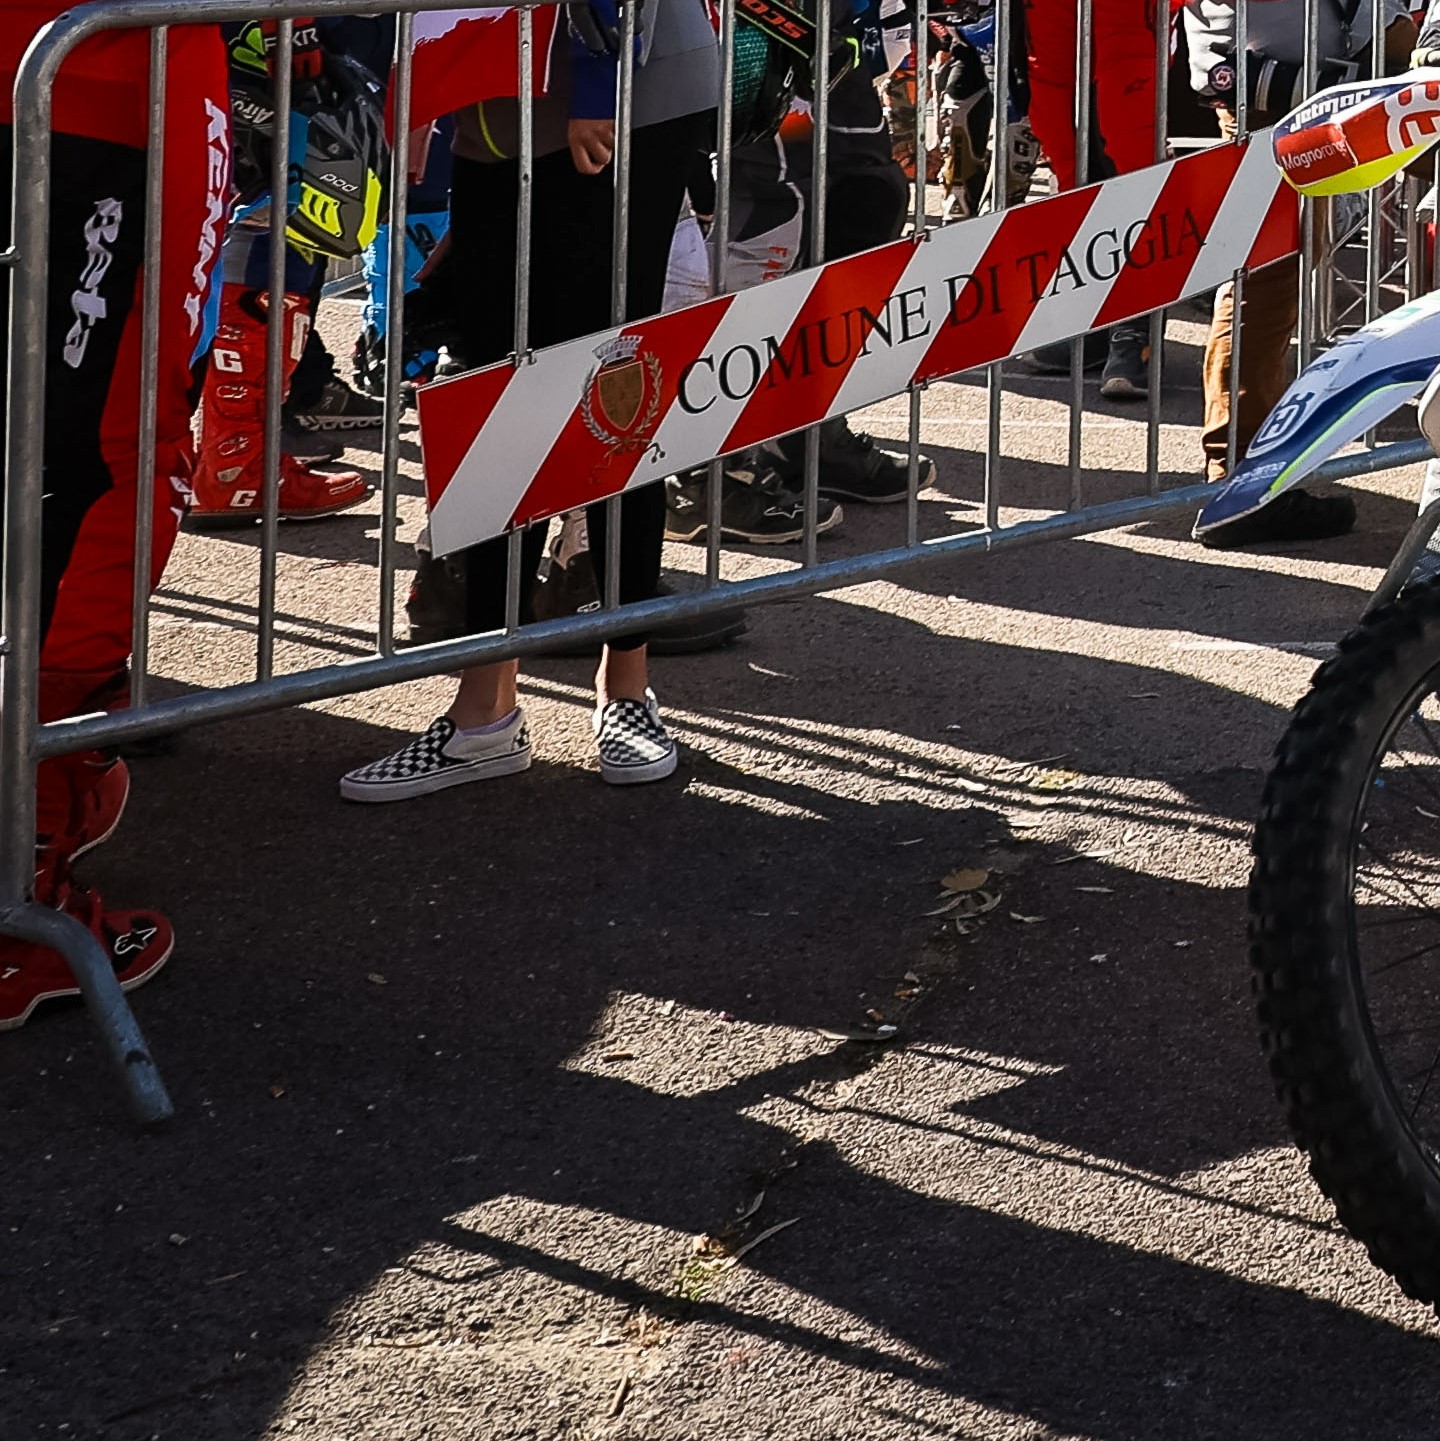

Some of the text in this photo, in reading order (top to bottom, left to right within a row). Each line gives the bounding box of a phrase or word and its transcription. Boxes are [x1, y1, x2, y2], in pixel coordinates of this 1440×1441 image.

[63, 197, 123, 368] Beta
[677, 206, 1206, 416] COMUNE DI TAGGIA
